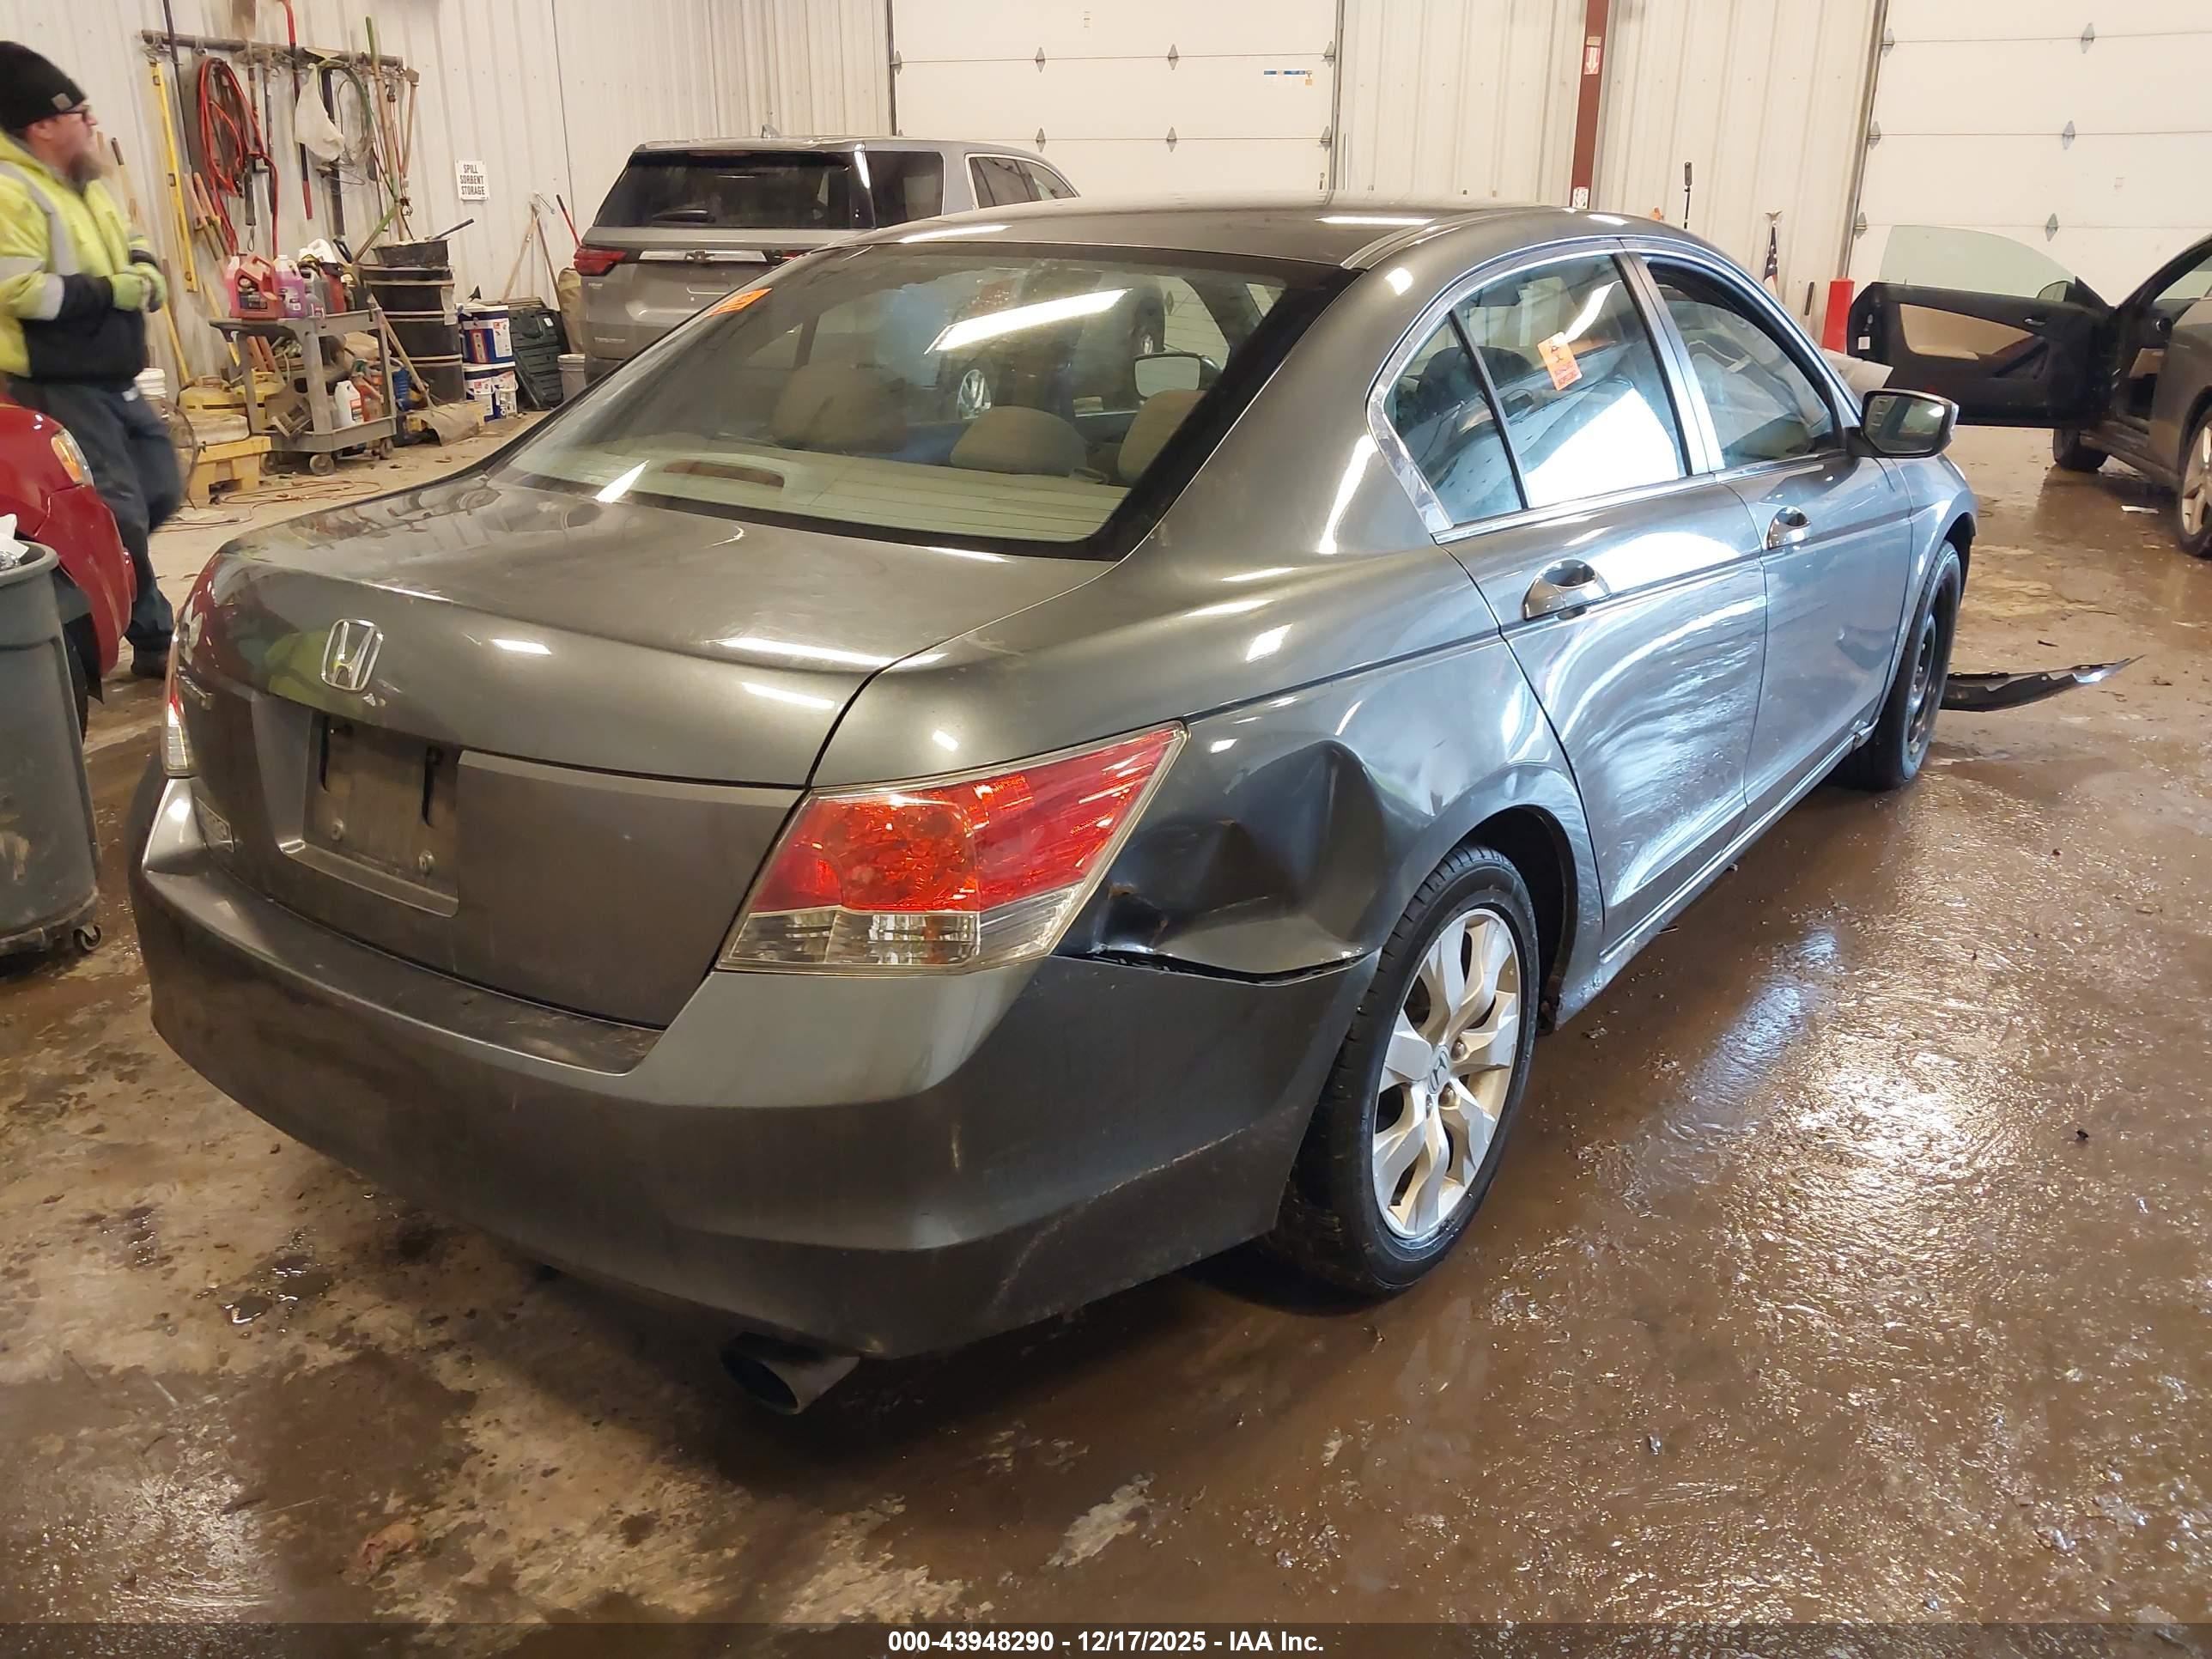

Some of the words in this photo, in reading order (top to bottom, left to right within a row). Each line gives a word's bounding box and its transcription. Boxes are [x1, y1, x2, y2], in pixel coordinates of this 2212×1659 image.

[463, 164, 478, 173] SPILL
[460, 175, 483, 184] SORBENT
[461, 185, 485, 195] STORAGE
